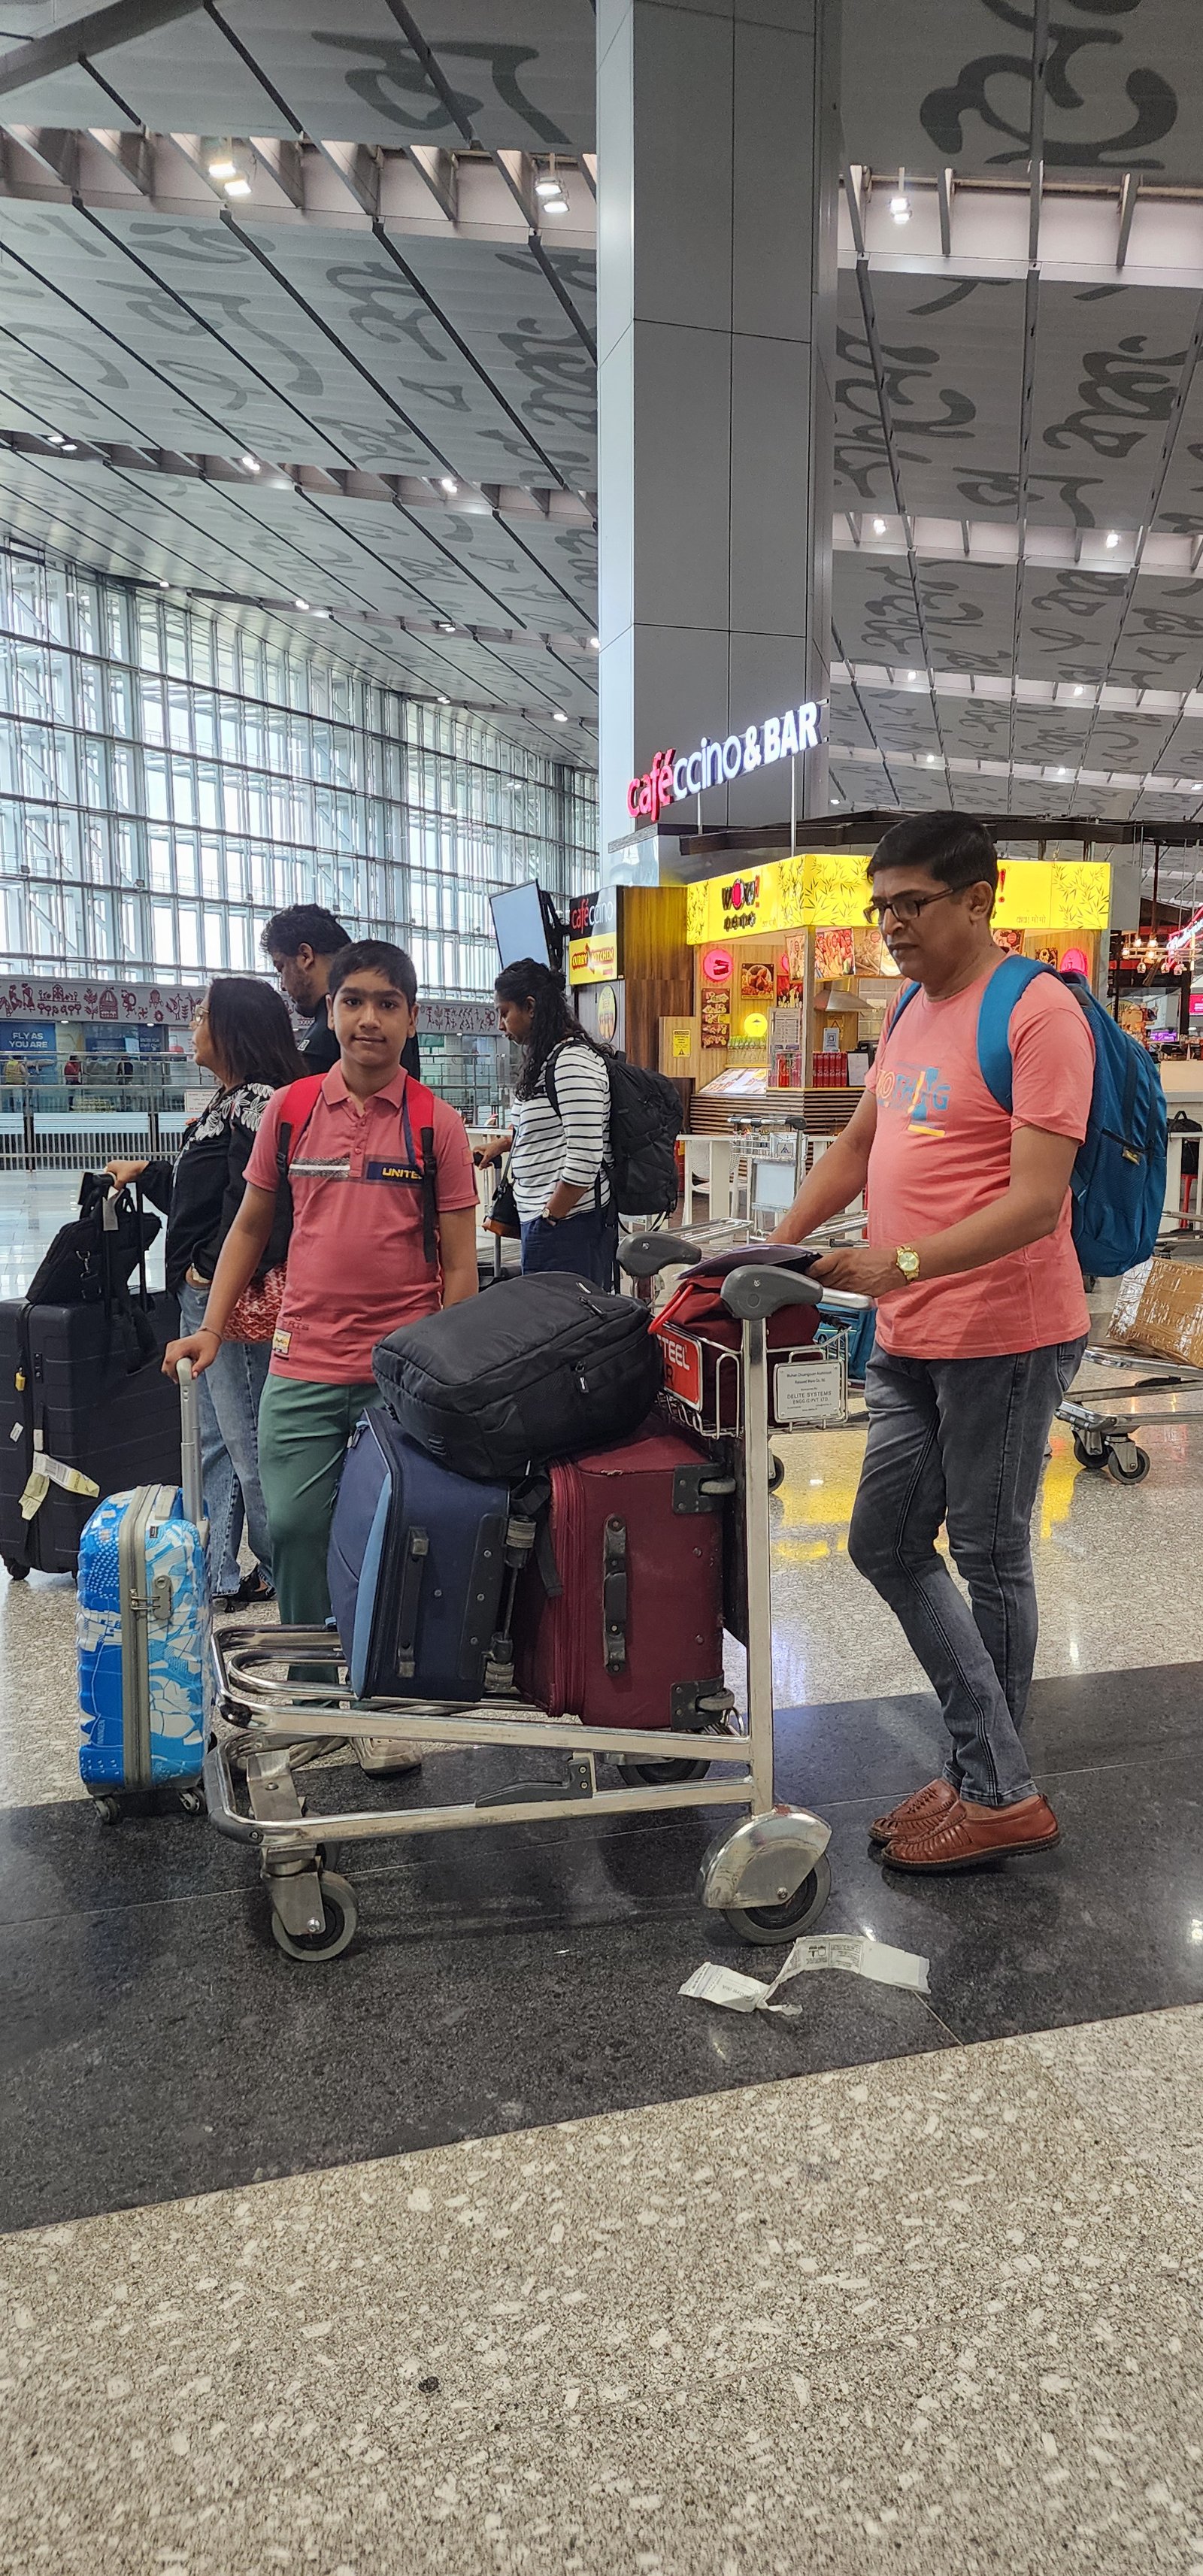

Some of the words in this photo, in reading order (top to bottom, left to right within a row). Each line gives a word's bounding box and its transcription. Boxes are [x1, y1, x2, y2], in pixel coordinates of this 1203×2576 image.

[571, 898, 614, 935] caféccino
[591, 948, 614, 963] KITCHEN
[12, 1032, 30, 1040] FLY
[8, 1040, 29, 1048] YOU
[382, 1167, 423, 1180] UNITE
[656, 1334, 690, 1371] TEEL
